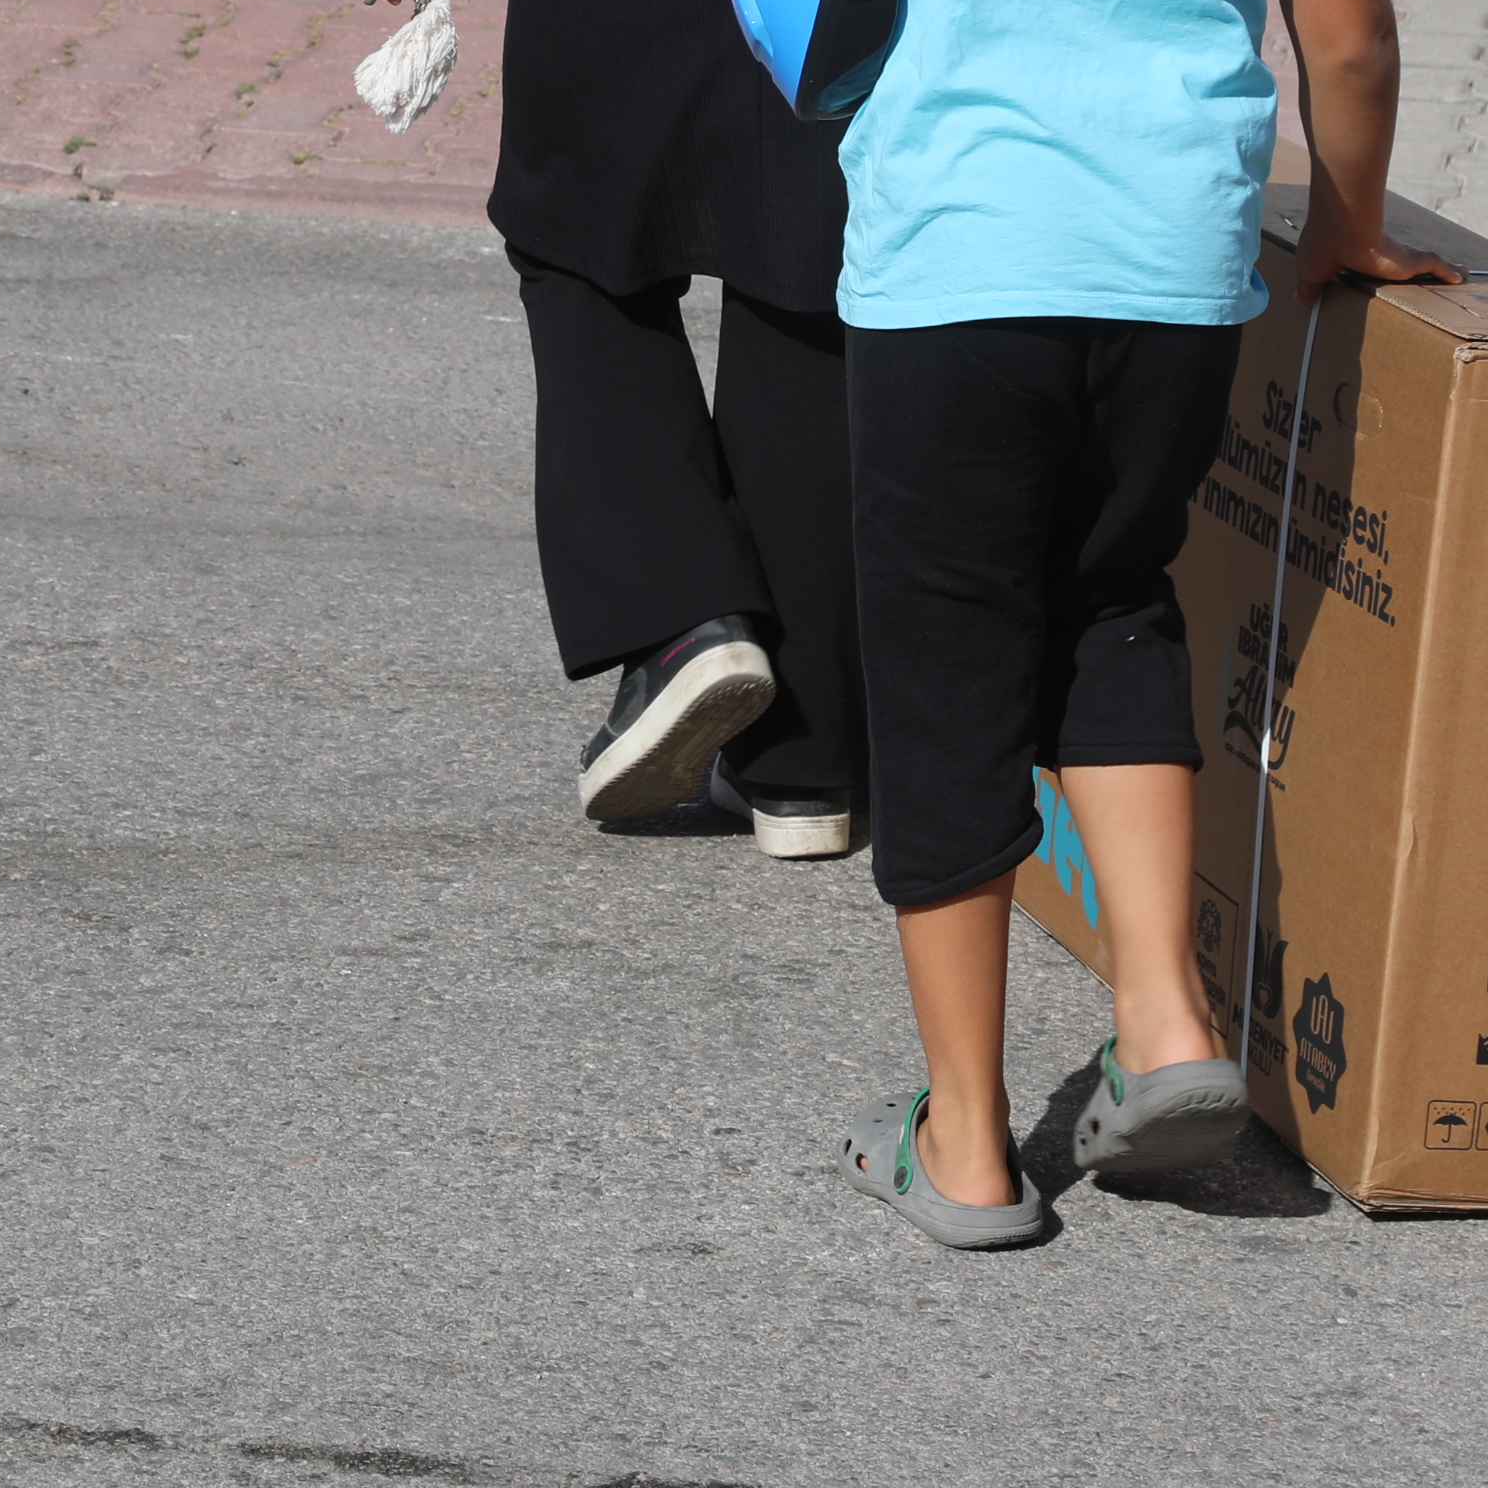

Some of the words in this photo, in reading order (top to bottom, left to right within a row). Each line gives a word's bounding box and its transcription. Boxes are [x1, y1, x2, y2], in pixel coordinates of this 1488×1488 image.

[1313, 481, 1390, 565] neşesi,
[1250, 602, 1288, 653] UĞR
[1299, 1037, 1337, 1082] ATABEY
